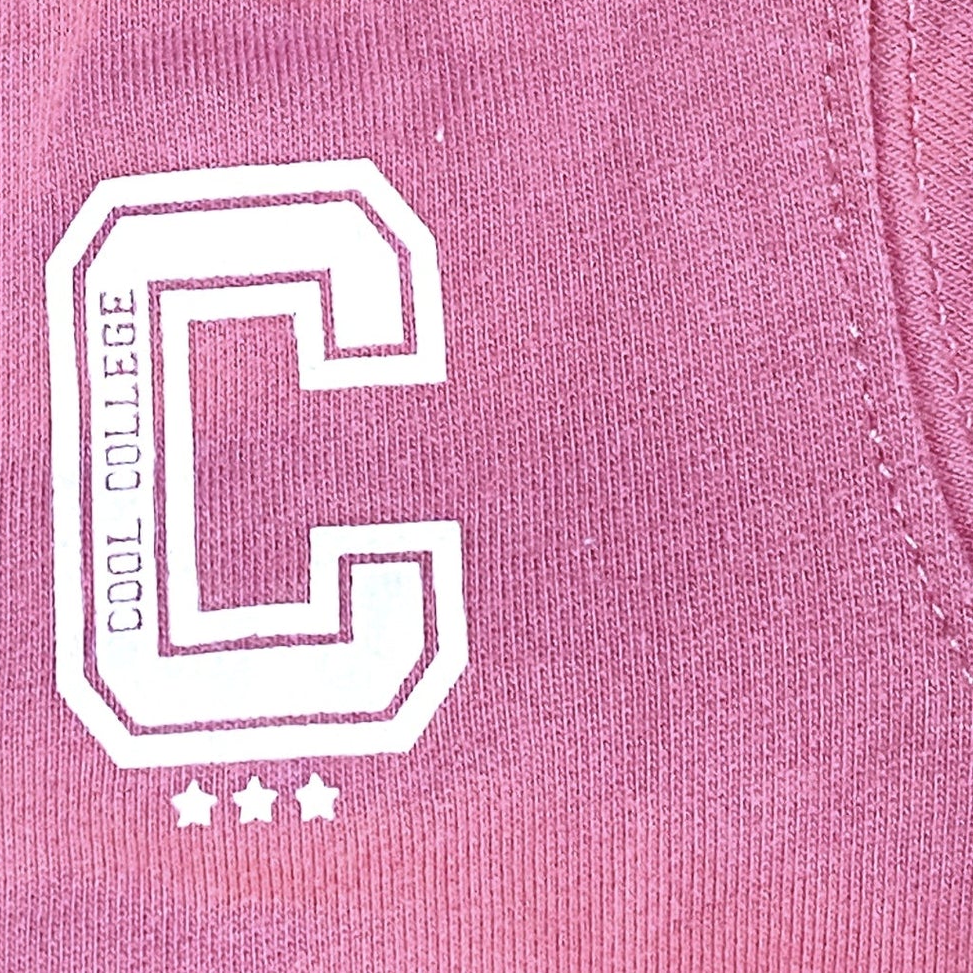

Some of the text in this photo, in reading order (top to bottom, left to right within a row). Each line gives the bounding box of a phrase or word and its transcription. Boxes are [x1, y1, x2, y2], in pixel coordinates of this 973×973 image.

[45, 158, 470, 769] C
[100, 289, 143, 633] COOL COLLEGE
